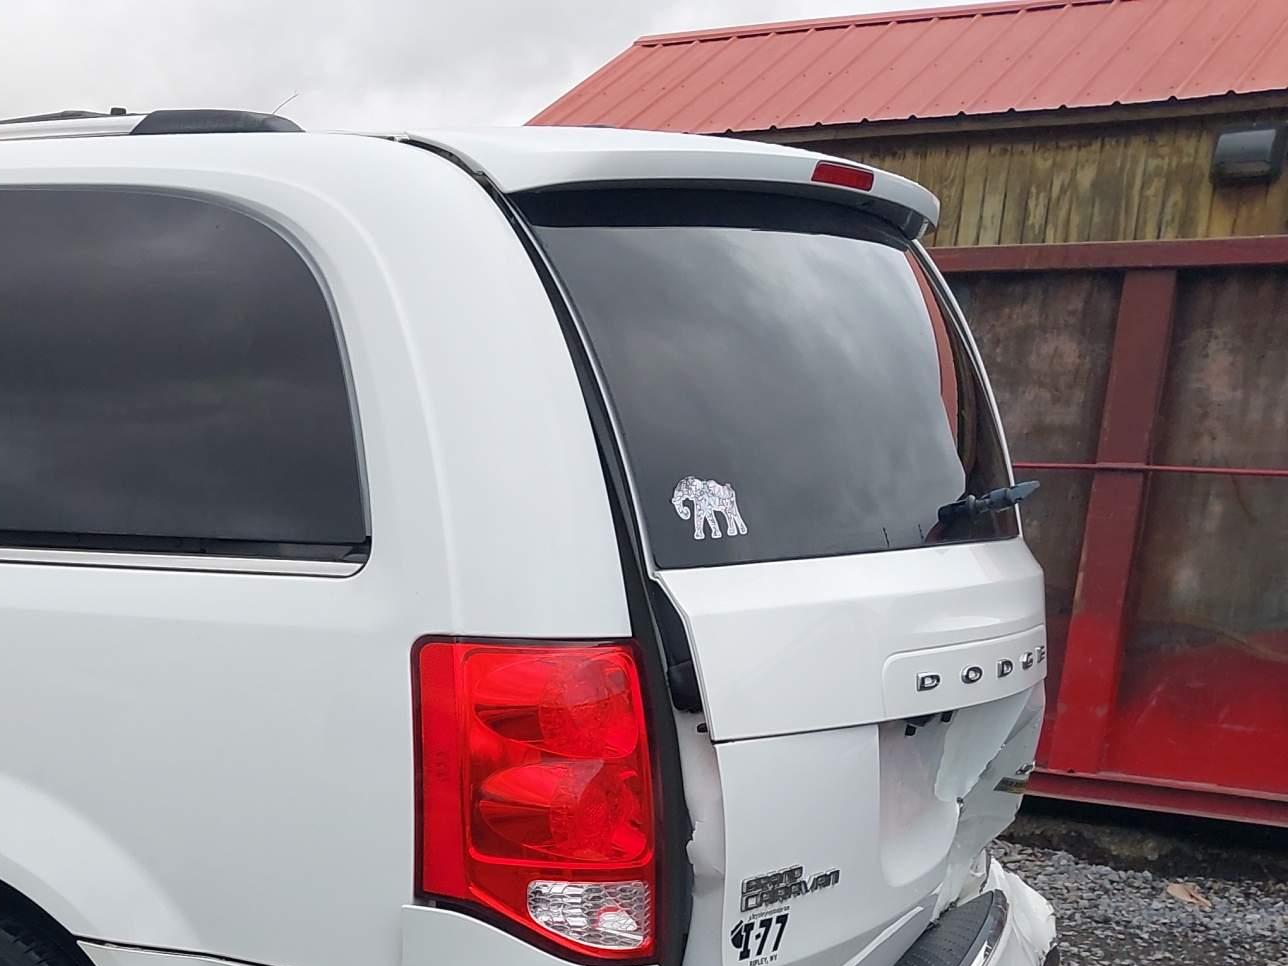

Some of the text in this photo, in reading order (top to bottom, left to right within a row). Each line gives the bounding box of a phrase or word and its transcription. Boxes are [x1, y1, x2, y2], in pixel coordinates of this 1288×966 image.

[916, 645, 1045, 692] DODGE
[740, 868, 841, 912] CARAVAN
[738, 913, 789, 961] I-77
